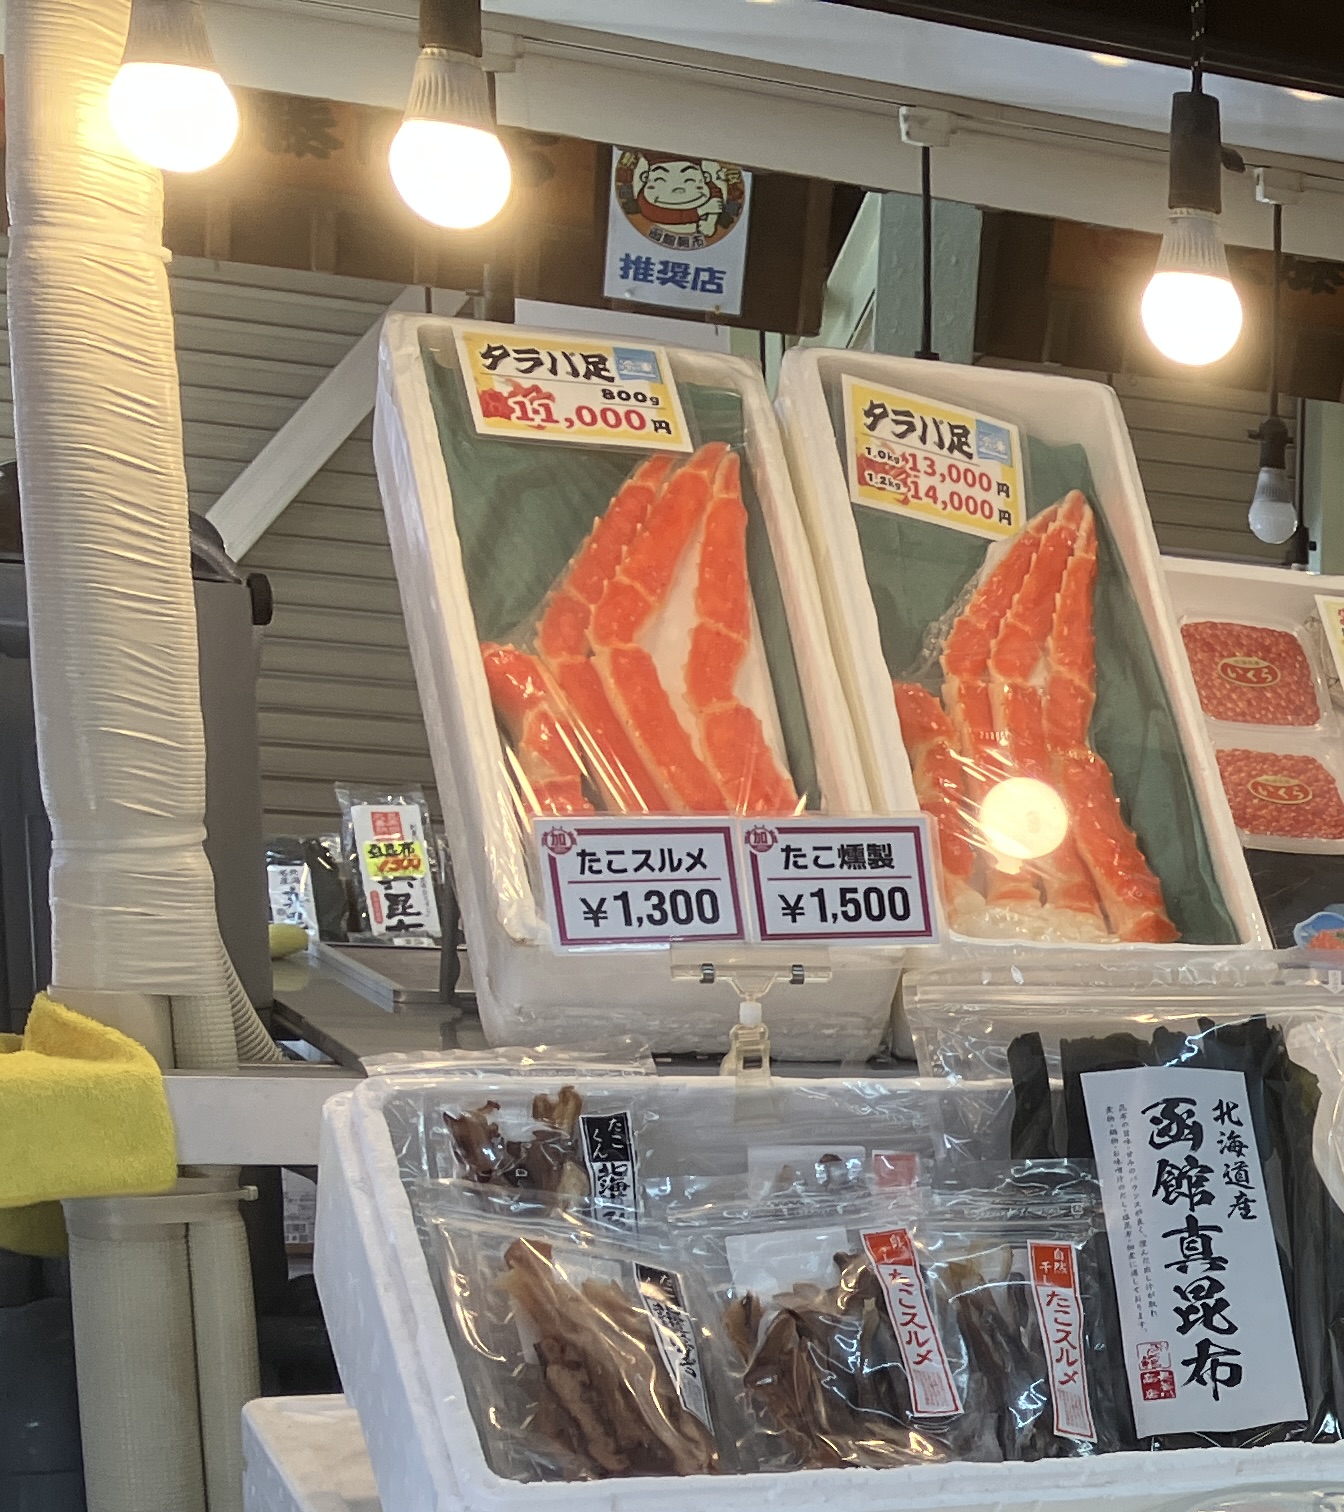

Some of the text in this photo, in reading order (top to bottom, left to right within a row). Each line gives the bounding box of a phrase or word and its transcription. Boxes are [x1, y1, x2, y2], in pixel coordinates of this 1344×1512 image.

[619, 253, 727, 294] 推奨店
[479, 343, 615, 382] タラバ足
[601, 388, 660, 406] 800g
[512, 399, 672, 435] 11,000円
[862, 400, 974, 460] タラバ足
[1227, 667, 1273, 683] いくら
[1257, 785, 1305, 800] いくら
[577, 848, 708, 876] たこスルメ
[781, 843, 895, 871] たこ燻製
[582, 888, 721, 928] ¥1,300
[780, 886, 911, 924] ¥1,500
[1212, 1098, 1257, 1220] 北海道産
[1140, 1097, 1243, 1402] 函館真昆布
[888, 1268, 934, 1366] たこスルメ
[1045, 1290, 1079, 1385] たこスルメ
